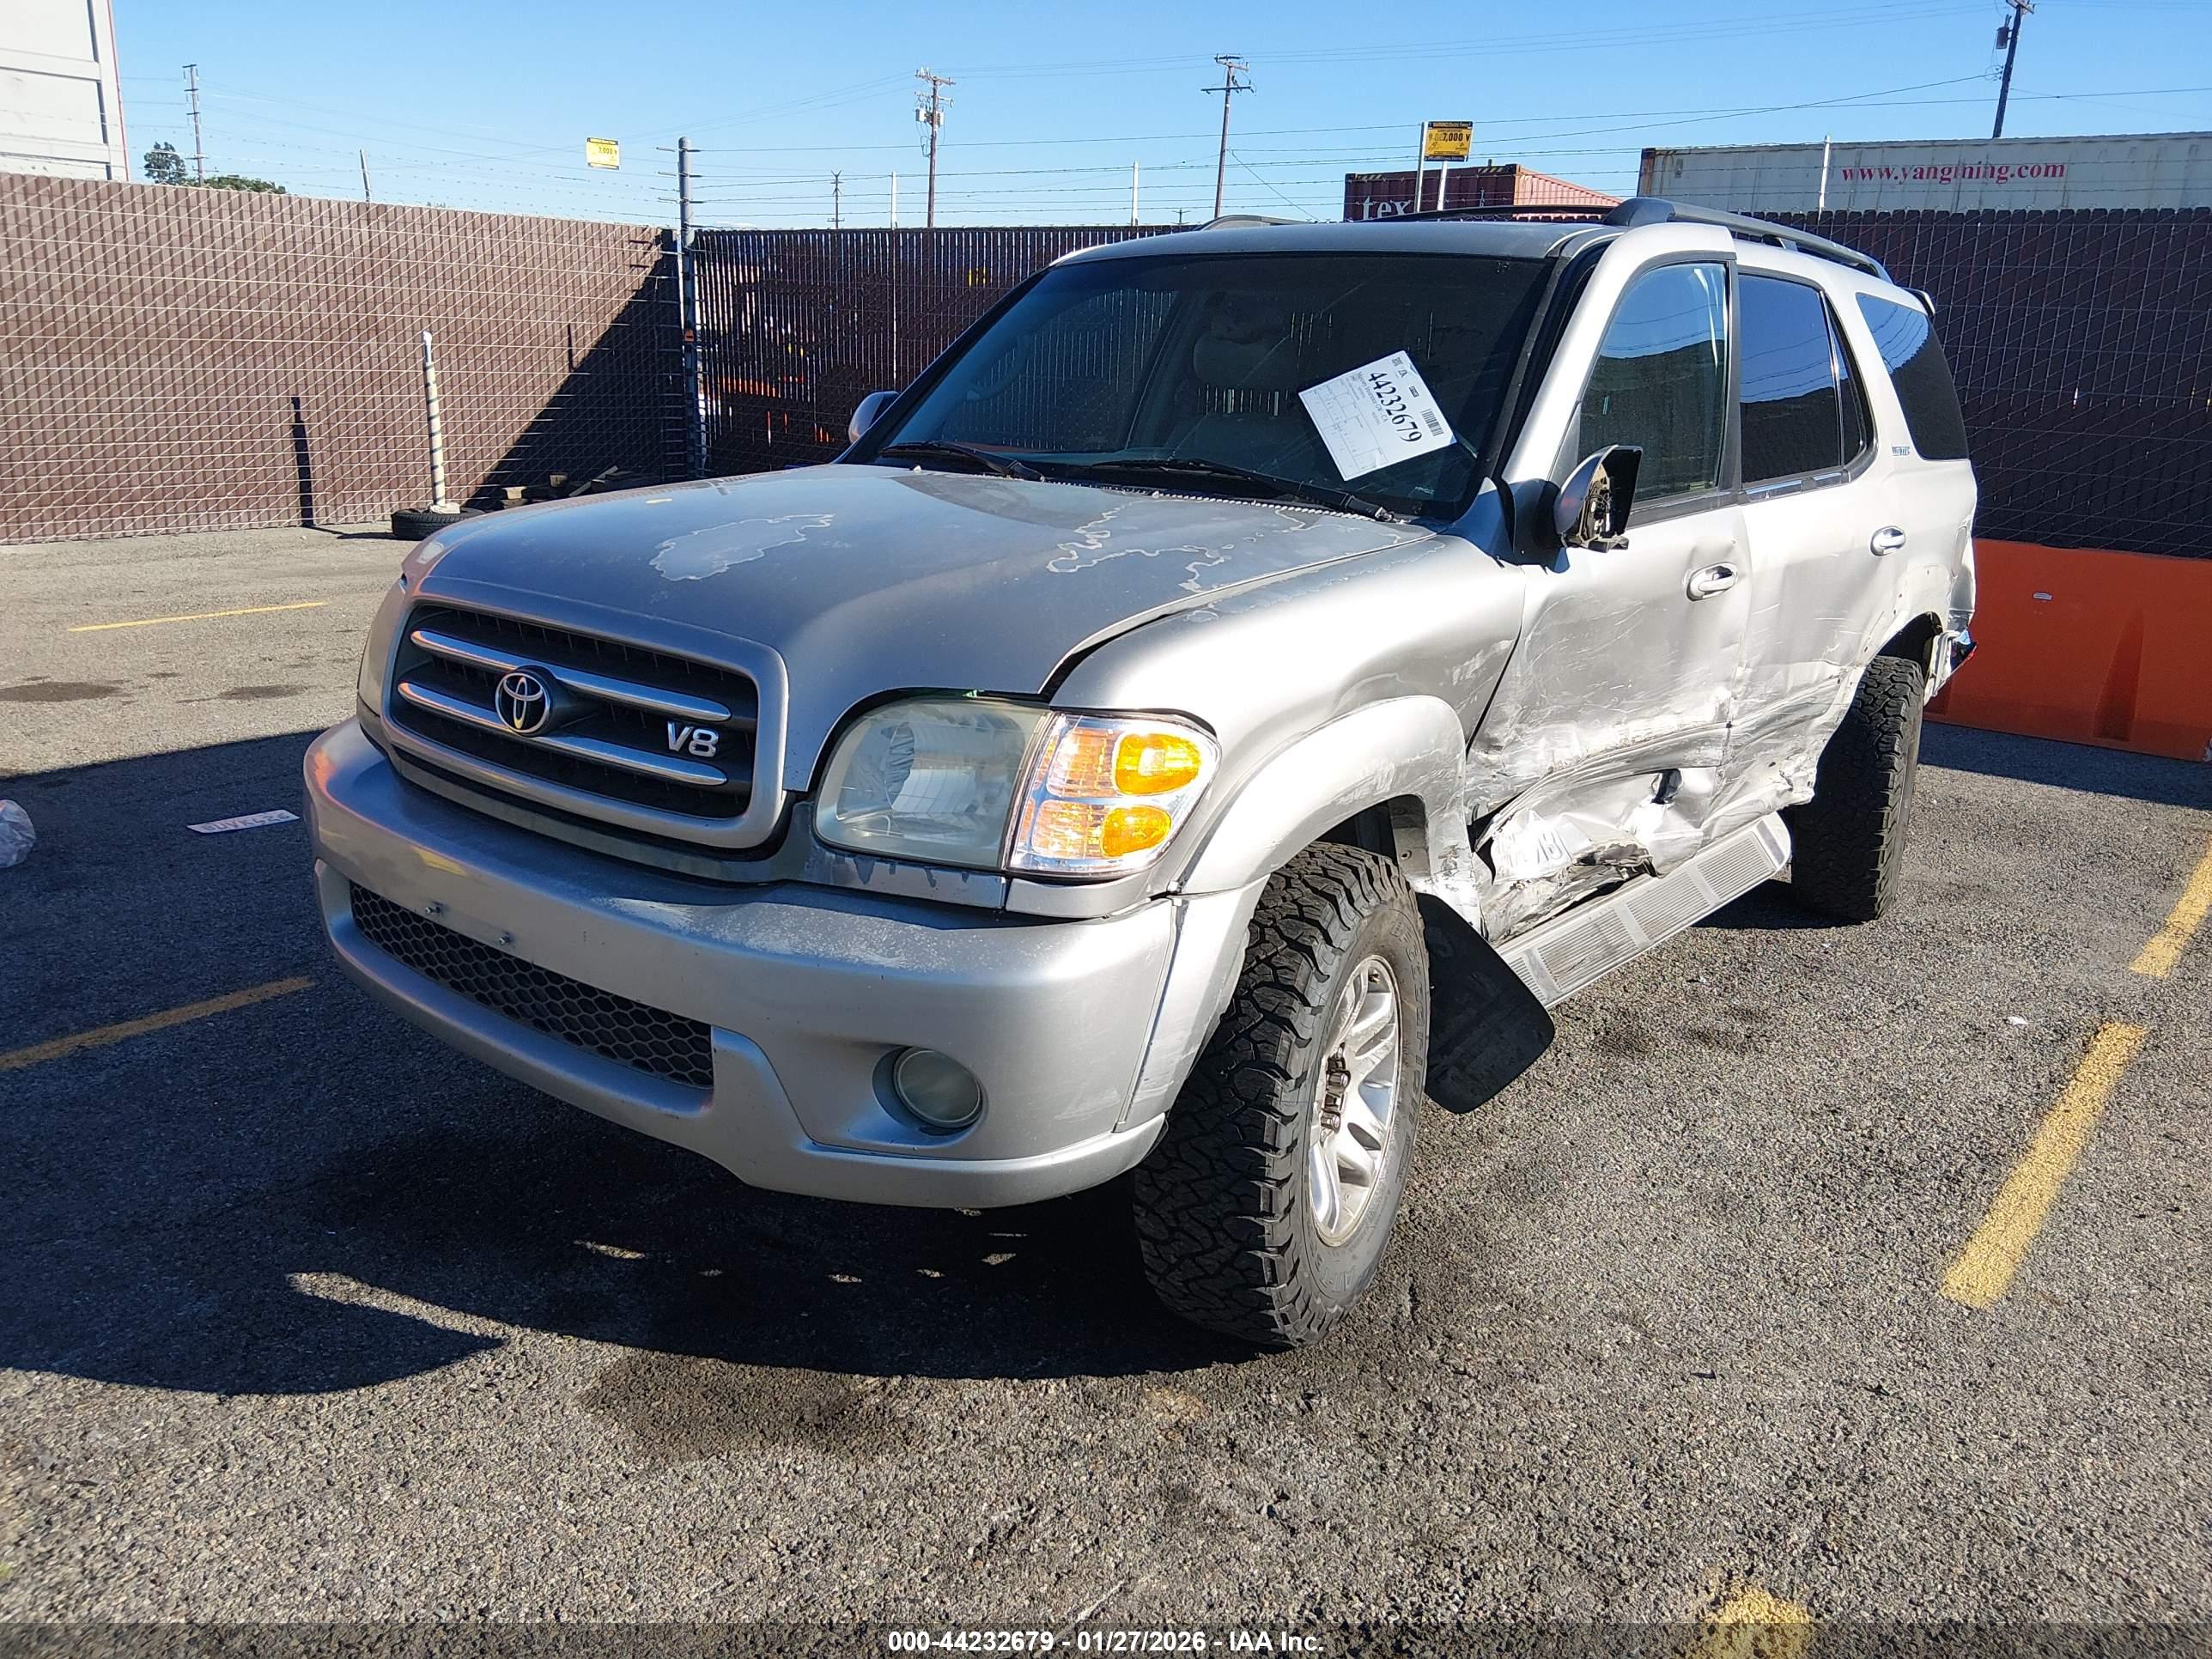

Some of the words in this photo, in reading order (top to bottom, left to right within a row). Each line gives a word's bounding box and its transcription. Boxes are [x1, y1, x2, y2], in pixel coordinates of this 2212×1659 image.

[1842, 161, 2065, 184] www.yangming.com
[1368, 372, 1422, 442] 44232679
[667, 721, 718, 757] V8
